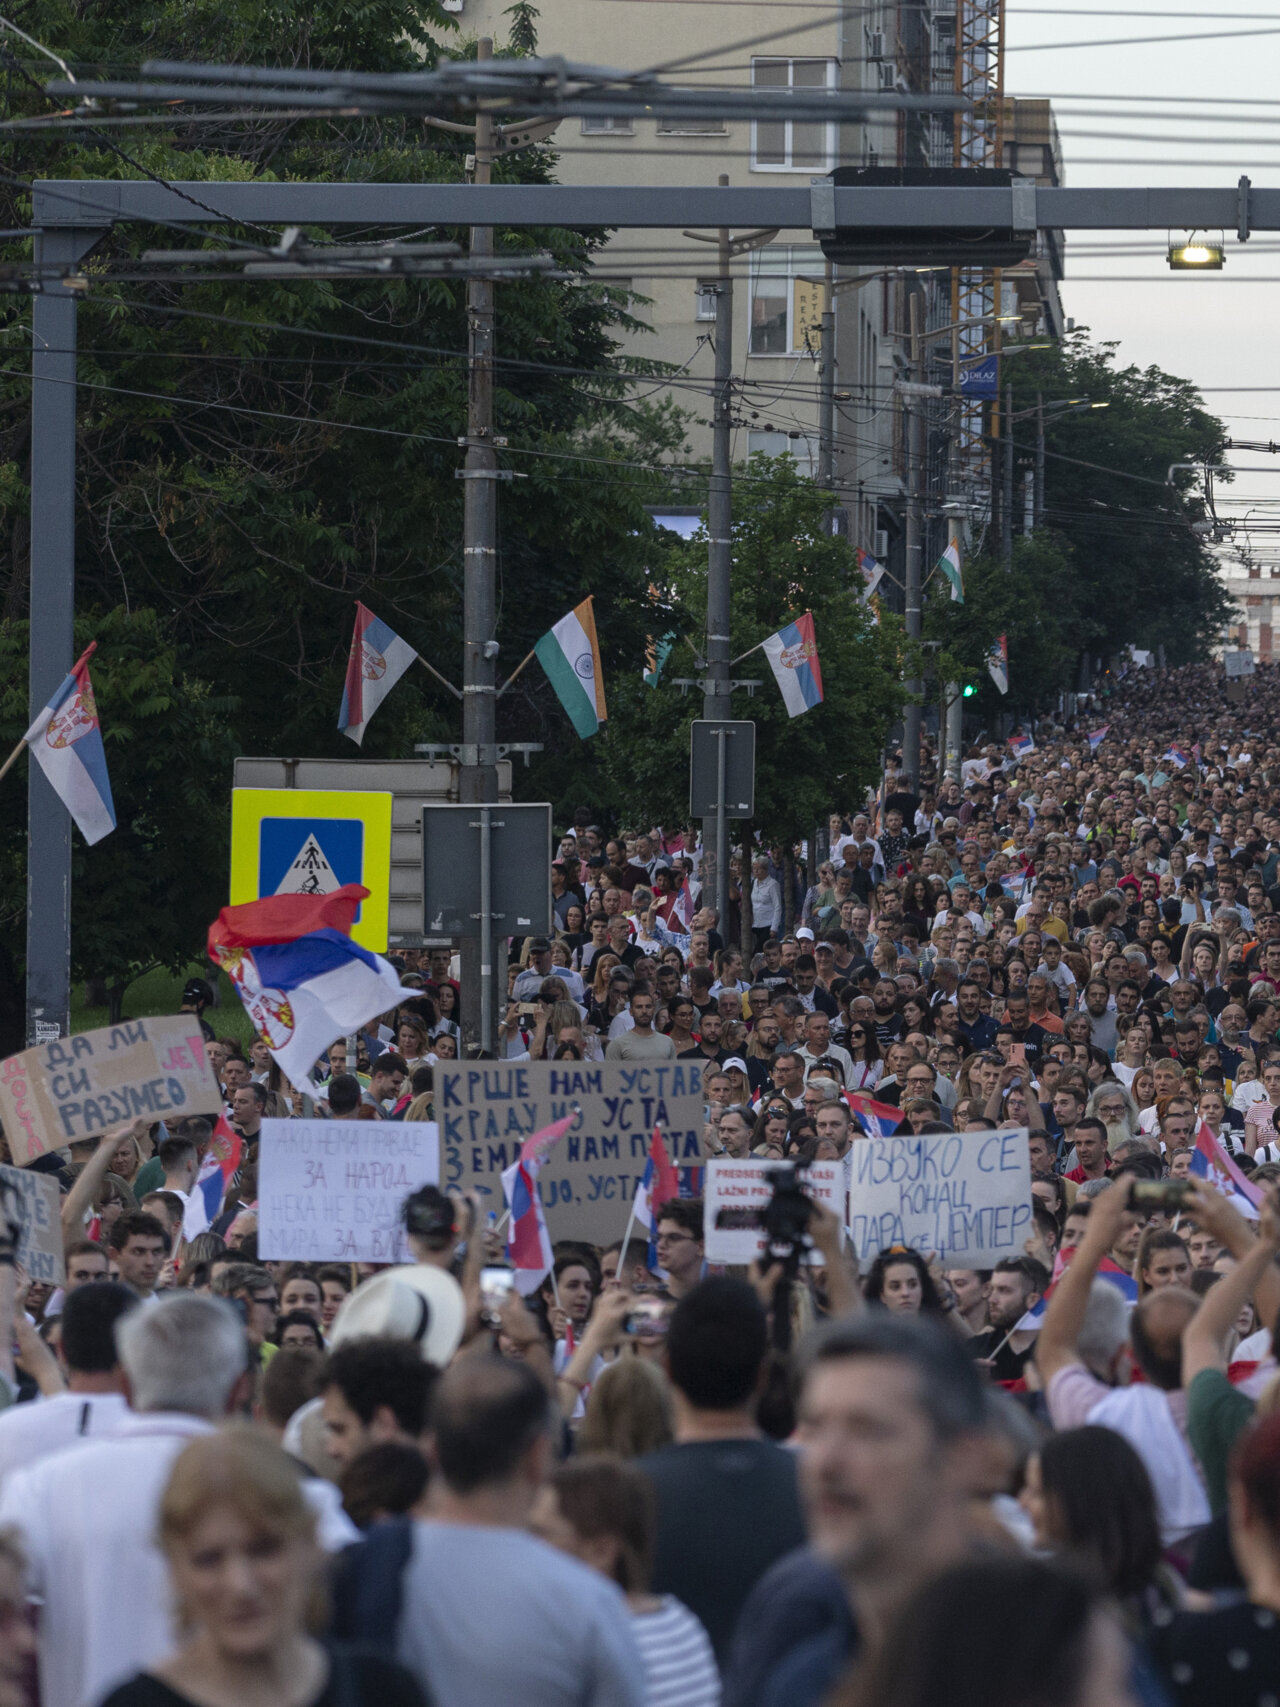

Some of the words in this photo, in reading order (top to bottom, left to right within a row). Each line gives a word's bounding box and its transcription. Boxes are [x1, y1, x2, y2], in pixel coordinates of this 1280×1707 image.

[810, 282, 819, 343] ESTAE
[45, 1036, 94, 1072] ДА
[107, 1020, 149, 1051] ЛИ
[51, 1068, 91, 1100] СИ
[58, 1076, 187, 1136] РАЗУМЕО
[443, 1068, 529, 1108] КРШЕ
[550, 1070, 604, 1096] НАМ
[620, 1066, 702, 1097] УСТАВ
[445, 1103, 537, 1145] КРАДУ
[603, 1097, 671, 1130] УСТА
[302, 1160, 328, 1189] ЗА
[343, 1161, 413, 1190] НАРОД
[446, 1142, 550, 1182] ЗЕМ
[568, 1135, 619, 1162] НАМ
[857, 1136, 963, 1186] ИЗВУКО
[977, 1134, 1022, 1172] СЕ
[270, 1194, 316, 1223] НЕКА
[323, 1195, 346, 1223] НЕ
[717, 1184, 748, 1196] LAŽNI
[899, 1180, 972, 1215] КОНАЦ
[267, 1229, 320, 1256] МИРА
[333, 1229, 358, 1257] ЗА
[370, 1229, 413, 1258] ВЛА
[852, 1212, 906, 1259] ПАРА
